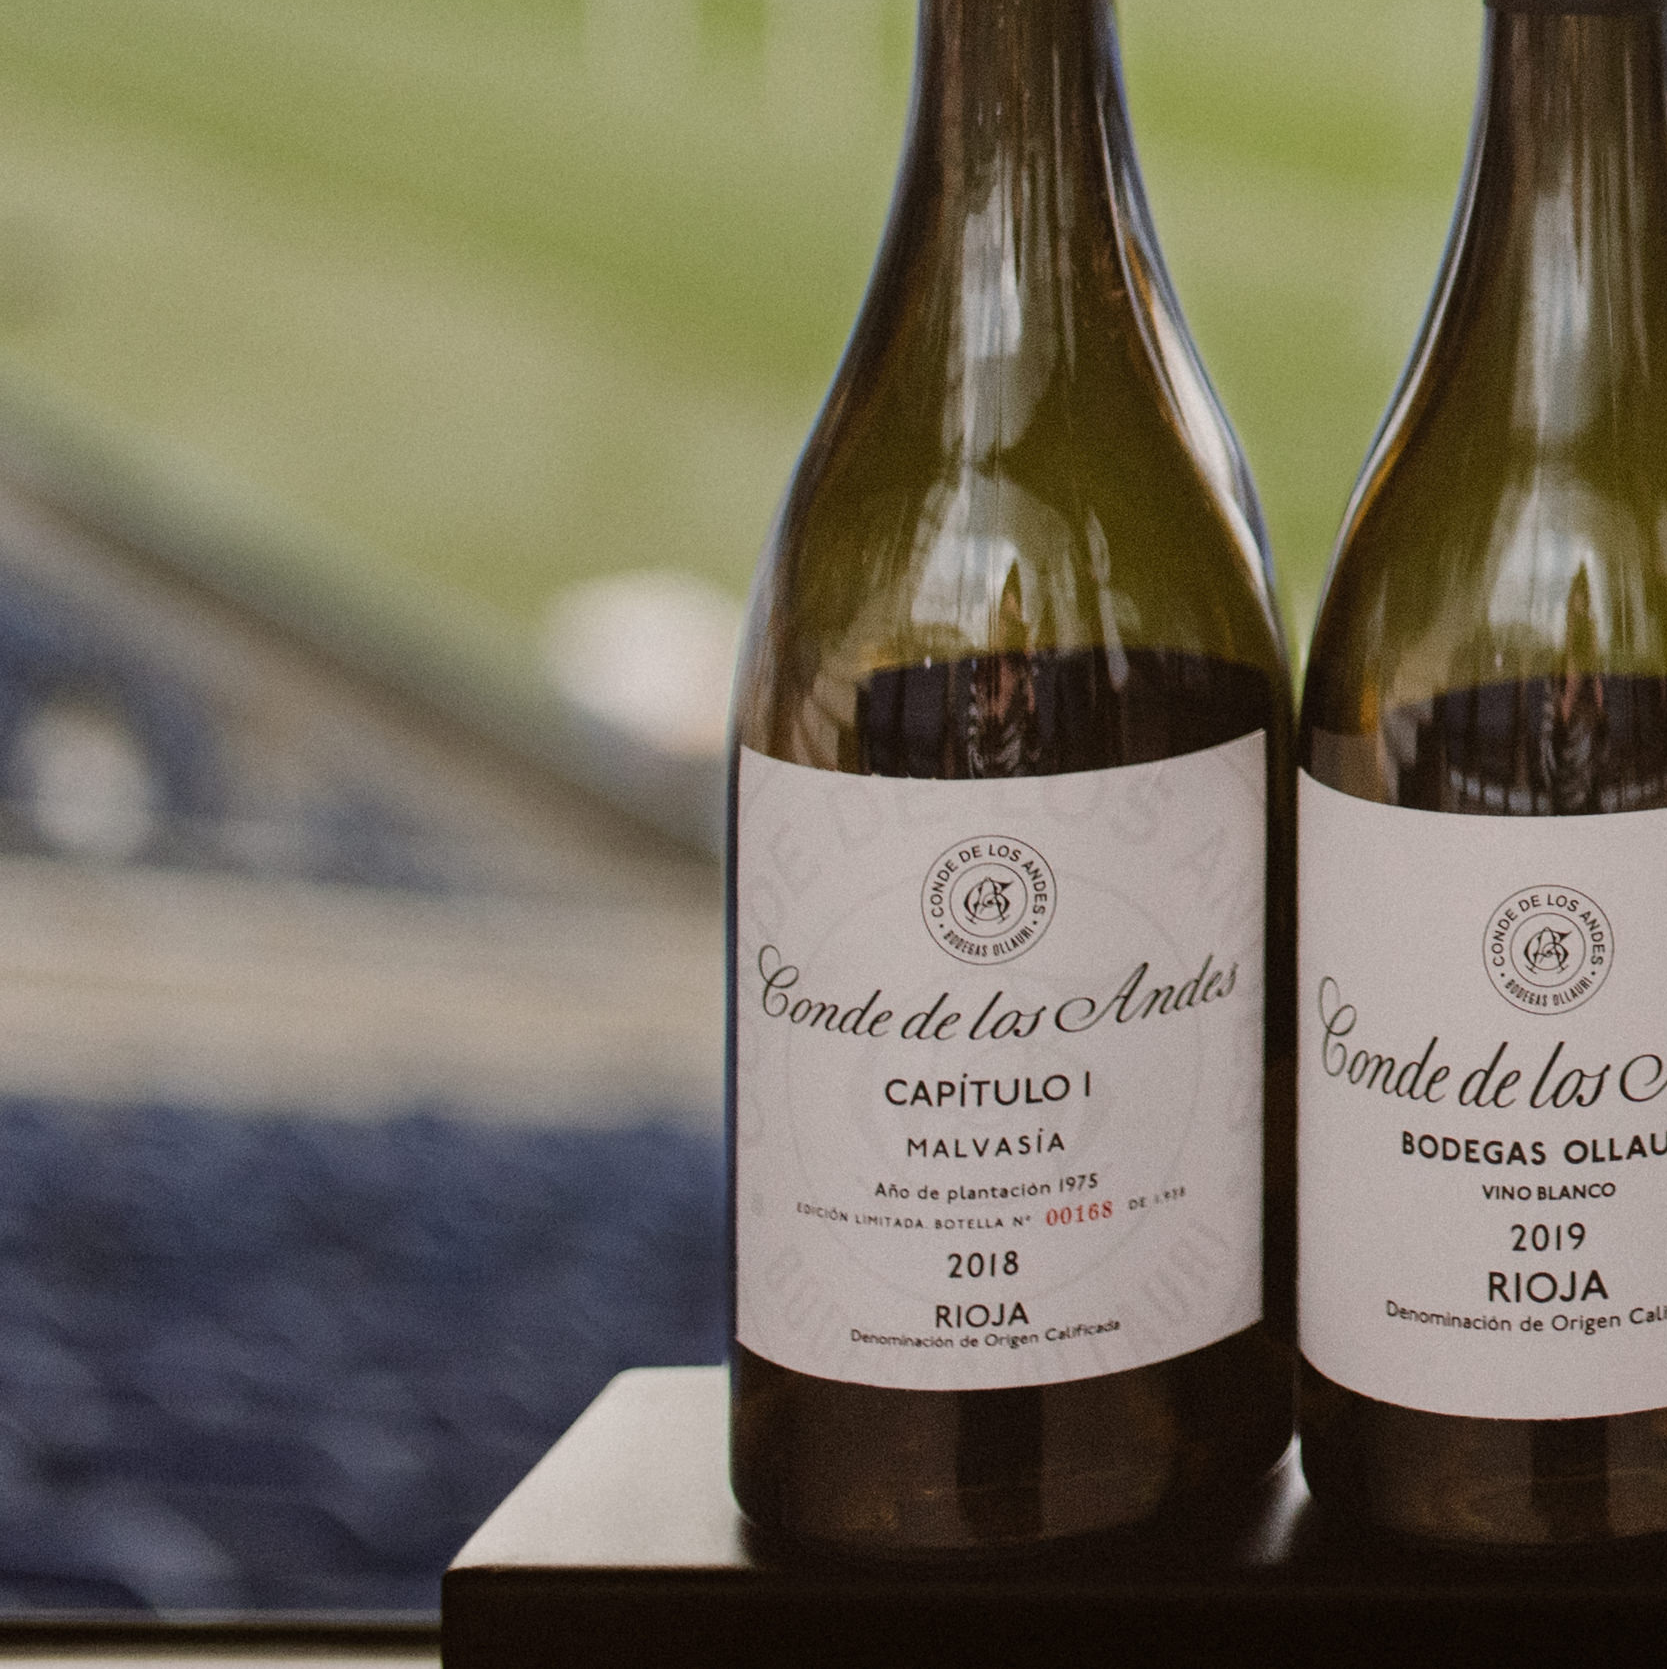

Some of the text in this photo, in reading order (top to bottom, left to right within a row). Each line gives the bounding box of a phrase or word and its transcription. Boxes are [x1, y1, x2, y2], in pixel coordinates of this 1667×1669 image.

[930, 844, 1047, 917] CONDE DE LOS ANDES
[1492, 894, 1605, 966] CONDE DE LOS ANDES
[758, 945, 1238, 1040] Conde de los Andes
[1319, 976, 1450, 1103] Conde
[1458, 1041, 1521, 1108] de
[1529, 1041, 1611, 1109] los
[885, 1073, 1070, 1107] CAPÍTULO
[907, 1128, 1065, 1158] MALVASÍA
[1402, 1131, 1546, 1166] BODEGAS
[875, 1172, 1098, 1204] Año de plantación 1975
[1482, 1182, 1616, 1201] VINO BLANCO
[796, 1201, 848, 1222] EDICIÓN
[935, 1217, 1004, 1230] BOTELLA
[1045, 1200, 1113, 1226] 00168
[1511, 1222, 1586, 1252] 2019
[948, 1250, 1019, 1278] 2018
[1489, 1270, 1609, 1303] RIOJA
[936, 1302, 1029, 1328] RIOJA
[1386, 1300, 1512, 1331] Denominación
[1519, 1316, 1543, 1332] de
[1551, 1314, 1621, 1336] Origen
[850, 1318, 1121, 1349] Denominación de Origen Calificada
